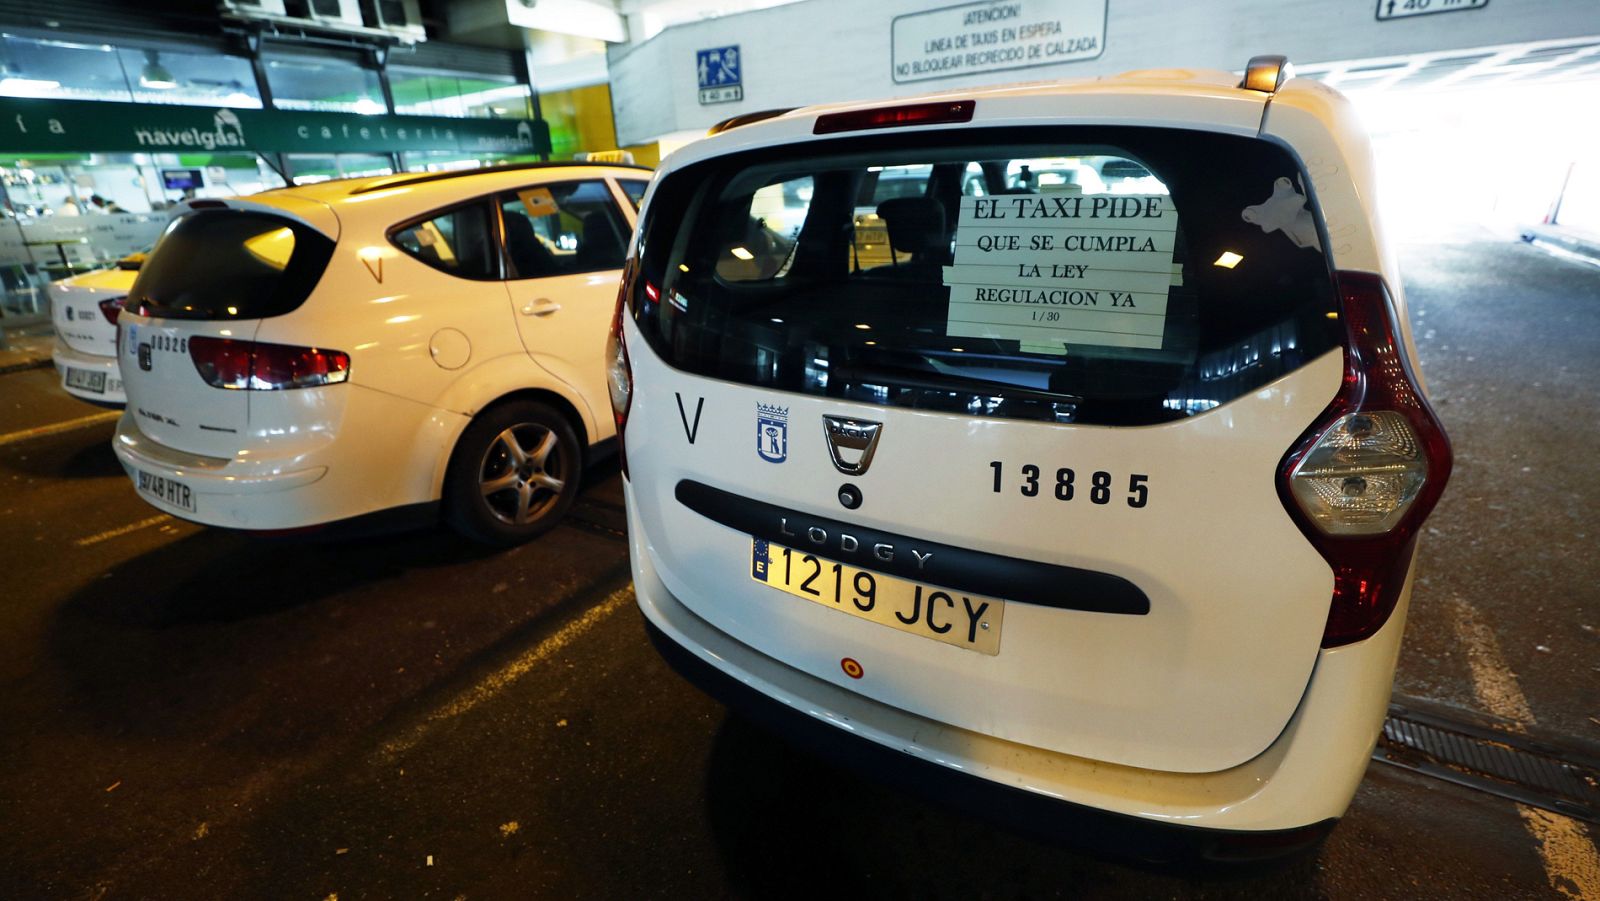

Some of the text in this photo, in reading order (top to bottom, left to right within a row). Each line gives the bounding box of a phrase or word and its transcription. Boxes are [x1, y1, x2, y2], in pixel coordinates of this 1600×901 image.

[955, 34, 968, 49] DE
[971, 30, 998, 46] TAXIS
[1002, 27, 1016, 43] EN
[1019, 20, 1062, 40] ESPERA
[896, 36, 1098, 76] NO BLOQUEAR RECRECIDO DE CALZADA
[974, 197, 1163, 219] EL TAXI PIDE
[977, 235, 1157, 253] QUE SE CUMPLA
[361, 257, 383, 284] V
[1018, 263, 1089, 279] LA LEY
[975, 287, 1136, 308] REGULACION YA
[675, 392, 704, 445] V
[166, 479, 191, 509] HTR
[990, 461, 1149, 509] 13885
[781, 518, 932, 569] LODGY
[756, 561, 764, 573] E
[783, 547, 989, 643] 1219 JCY
